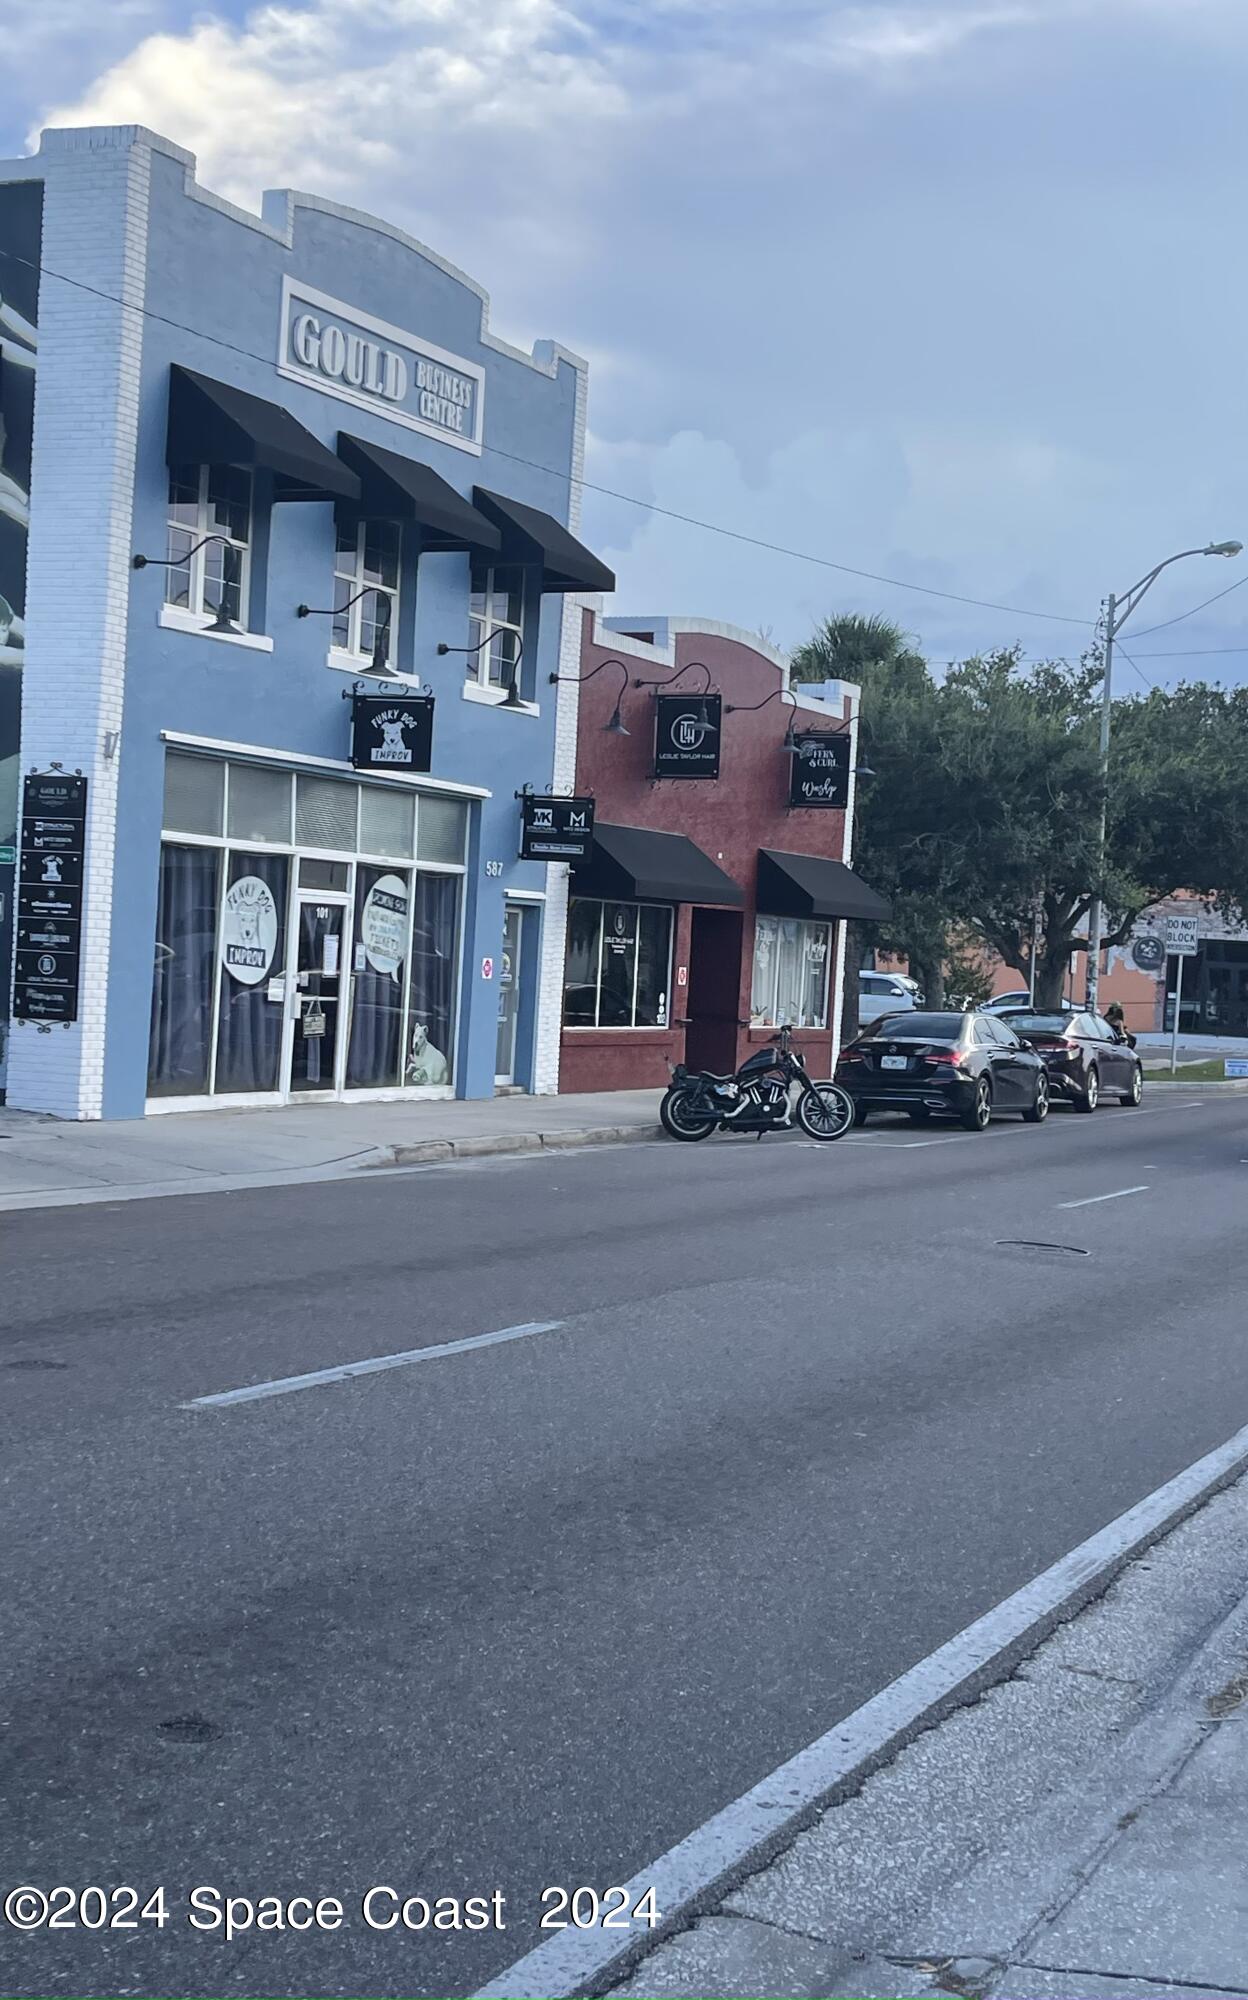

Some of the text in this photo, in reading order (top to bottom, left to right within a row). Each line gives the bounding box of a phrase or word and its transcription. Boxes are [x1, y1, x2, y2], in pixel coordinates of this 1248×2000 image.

[294, 314, 408, 402] GOULD
[415, 360, 472, 409] BUSINESS
[419, 390, 463, 432] CENTRE
[371, 709, 418, 729] FUNKY DOG
[375, 750, 409, 760] IMPROV
[486, 861, 503, 877] 587
[227, 882, 256, 911] FUNKY
[316, 907, 329, 919] 101
[1168, 919, 1197, 930] DO NOT
[1167, 932, 1195, 943] BLOCK
[229, 946, 264, 967] IMPROV
